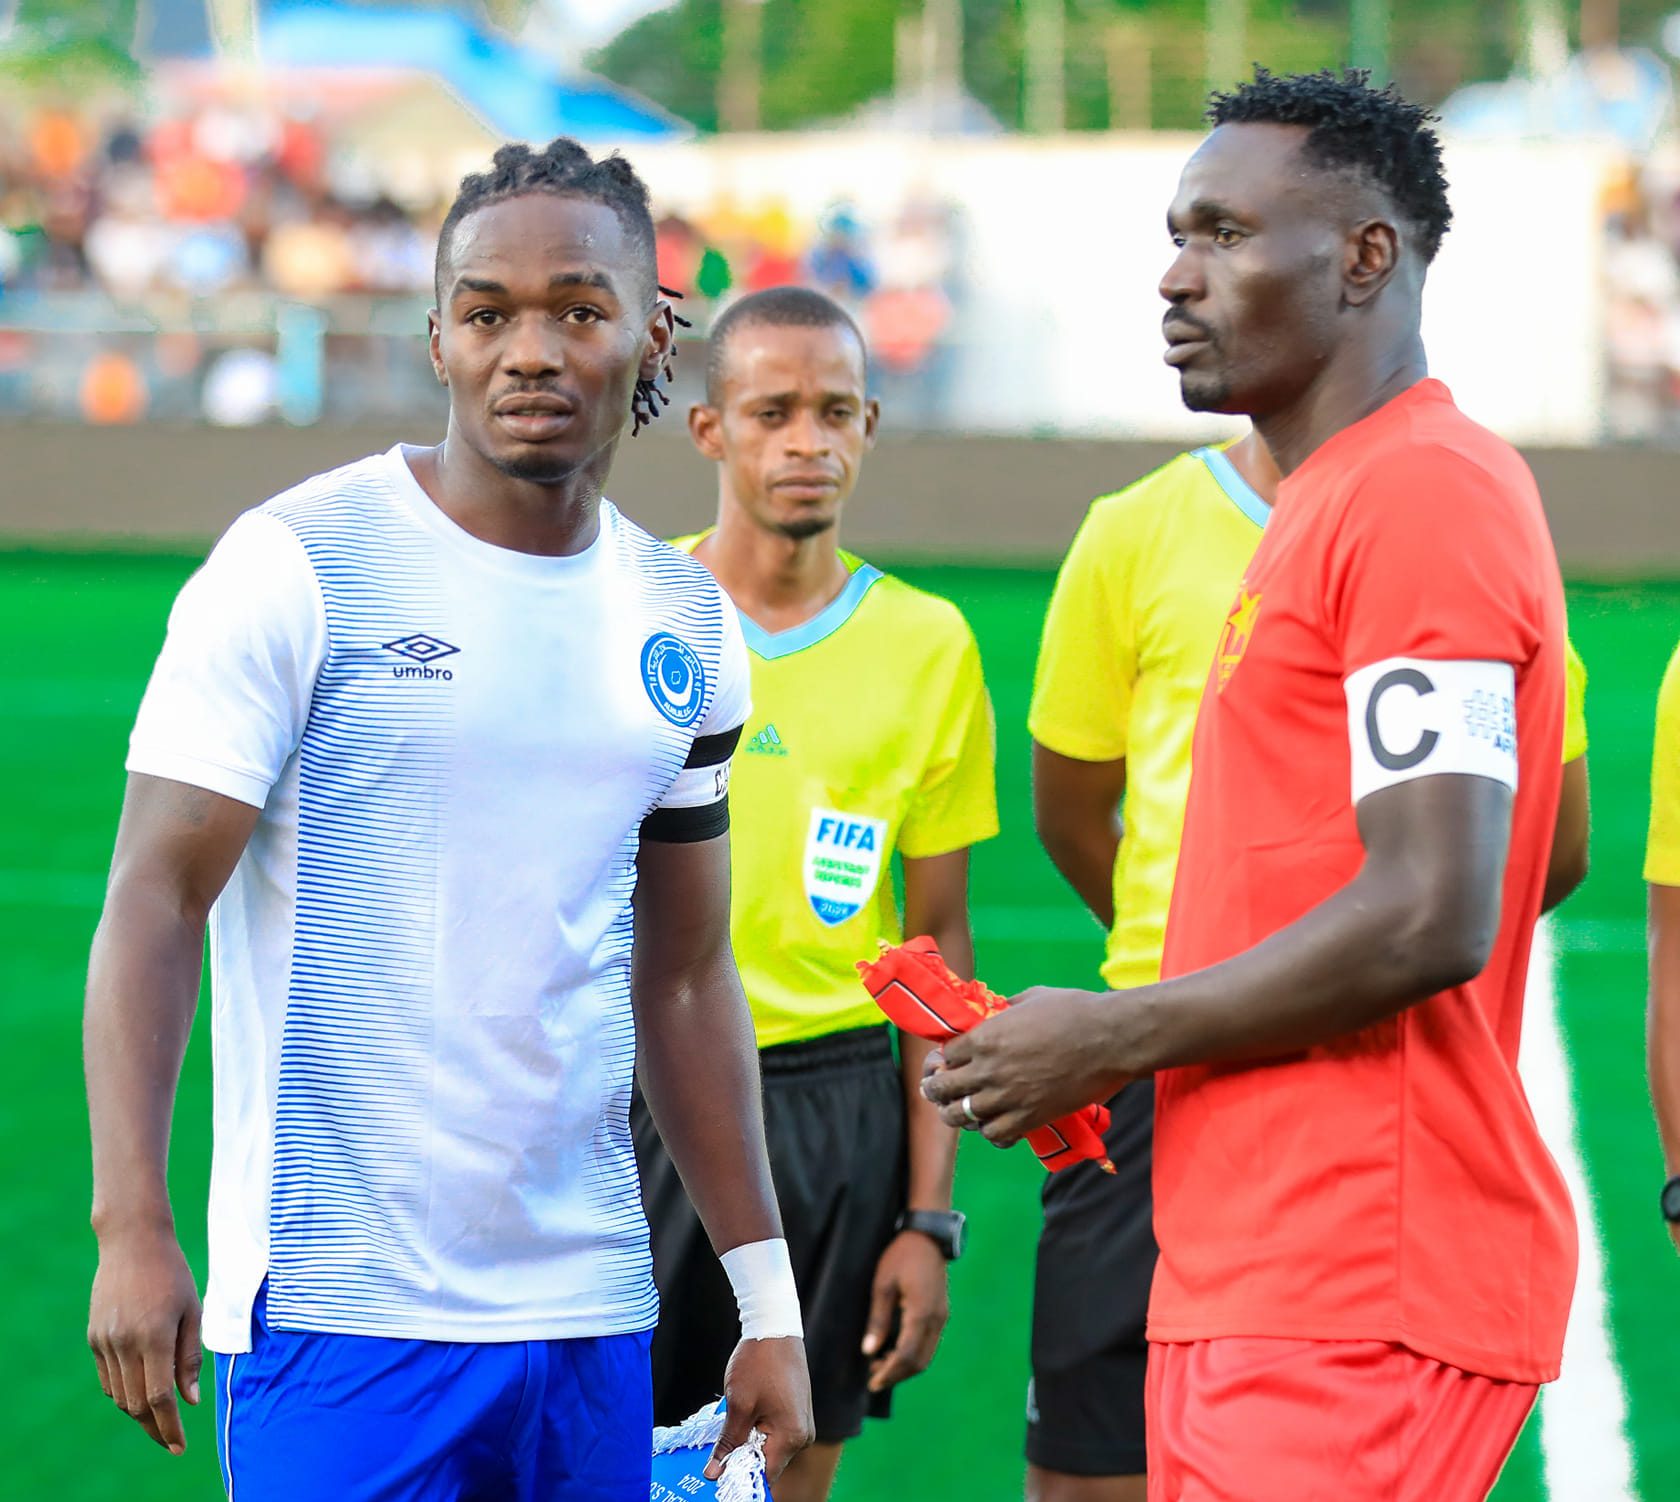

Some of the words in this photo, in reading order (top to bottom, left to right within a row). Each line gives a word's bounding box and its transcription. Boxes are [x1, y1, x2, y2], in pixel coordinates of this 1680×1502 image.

[393, 665, 453, 681] umbro
[1365, 668, 1440, 771] C
[816, 818, 875, 851] FIFA
[676, 1473, 706, 1495] 2024
